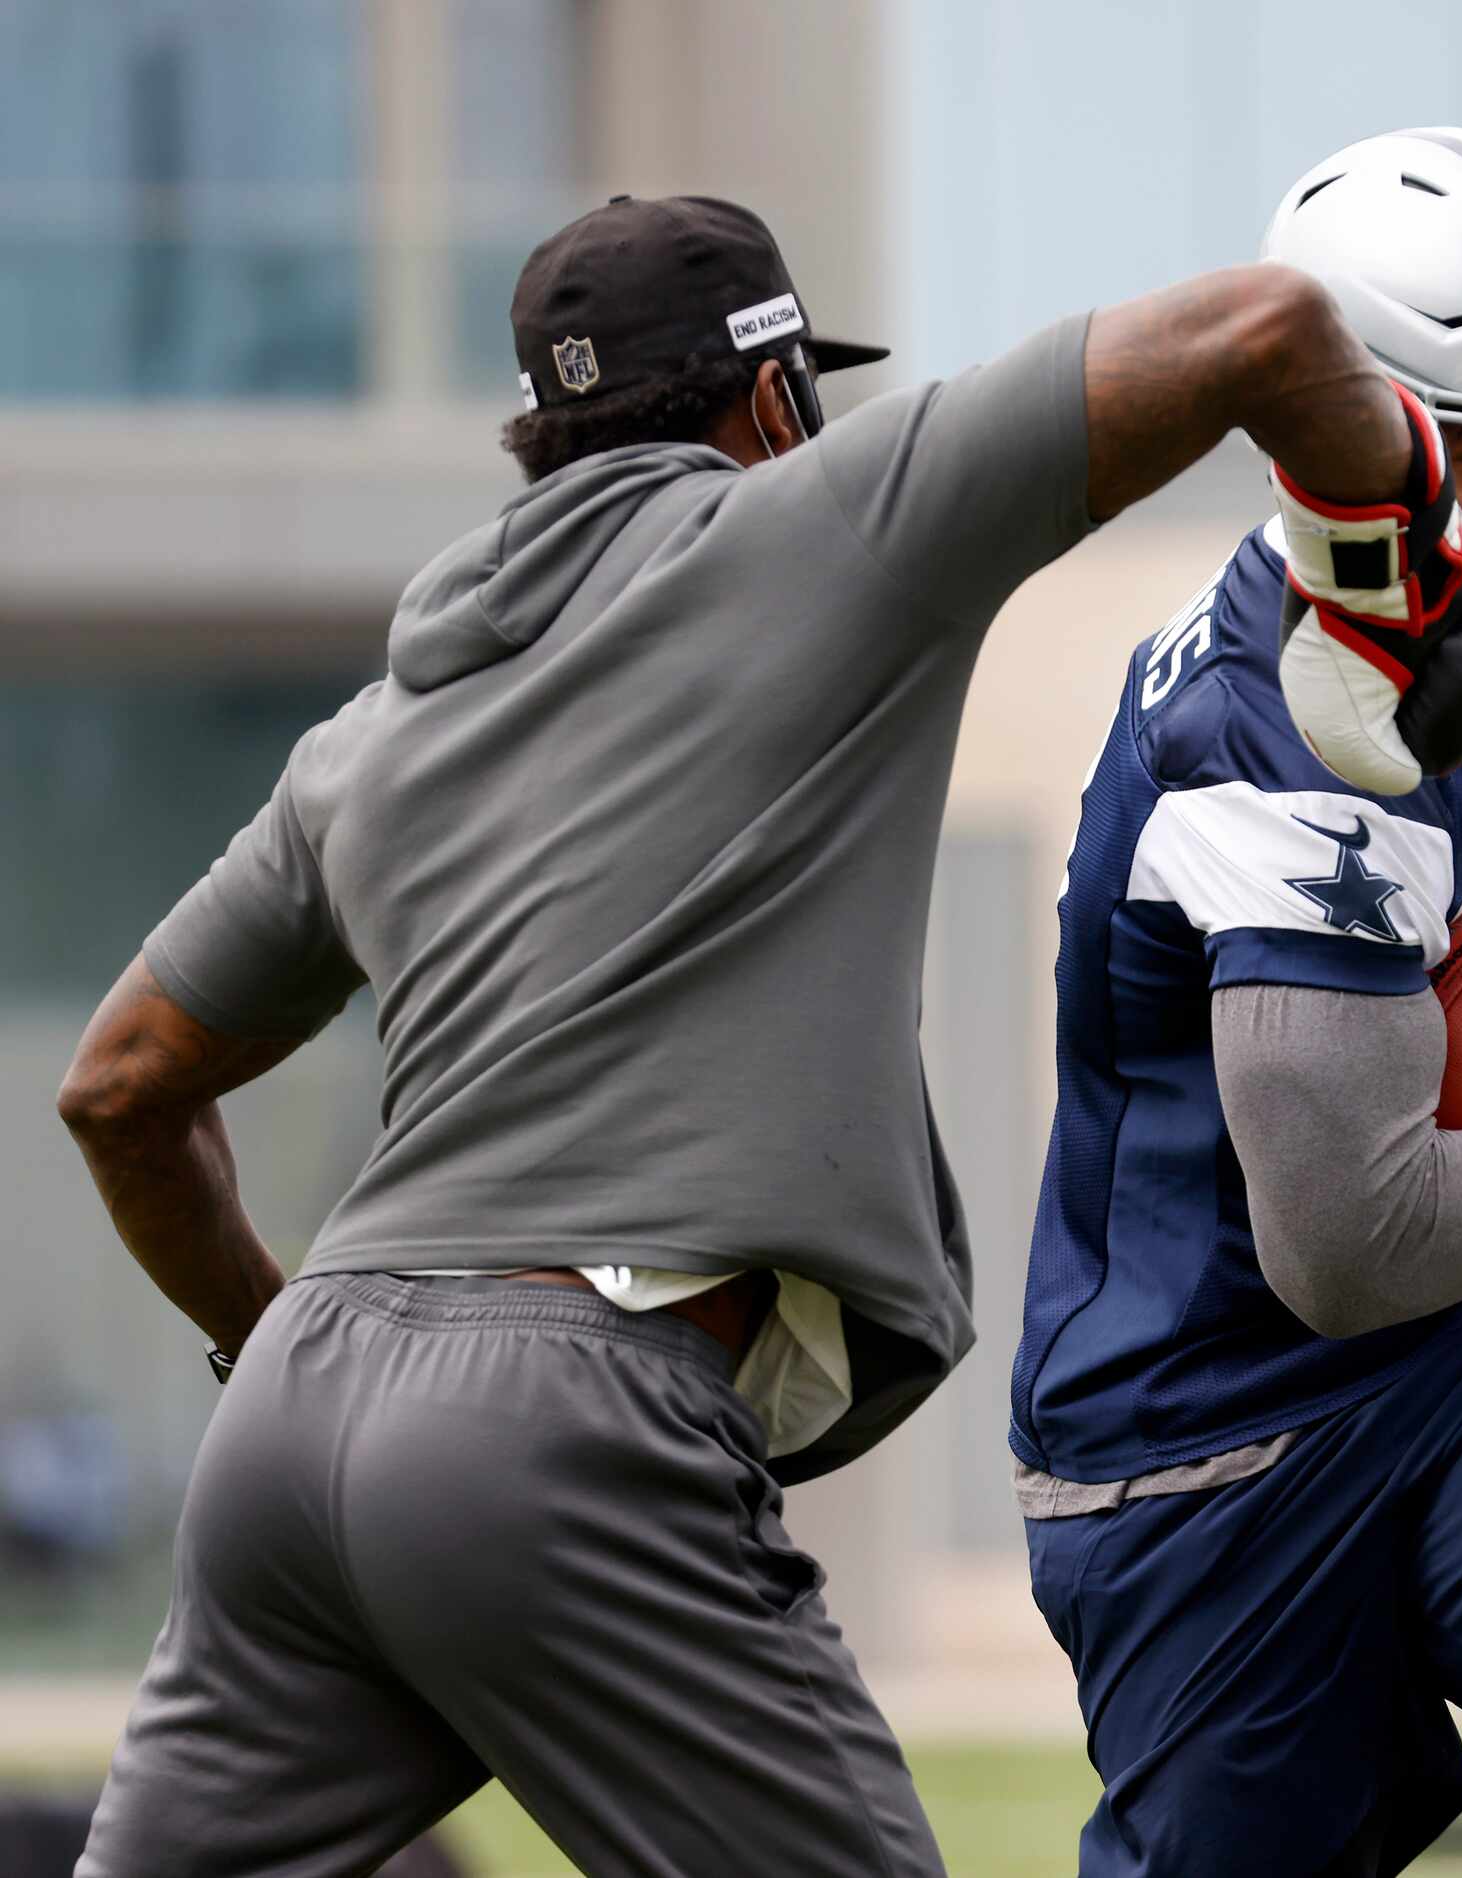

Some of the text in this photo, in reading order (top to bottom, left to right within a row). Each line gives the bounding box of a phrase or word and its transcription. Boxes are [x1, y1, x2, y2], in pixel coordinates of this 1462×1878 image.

[734, 305, 798, 339] END RACISM
[562, 356, 594, 384] NFL
